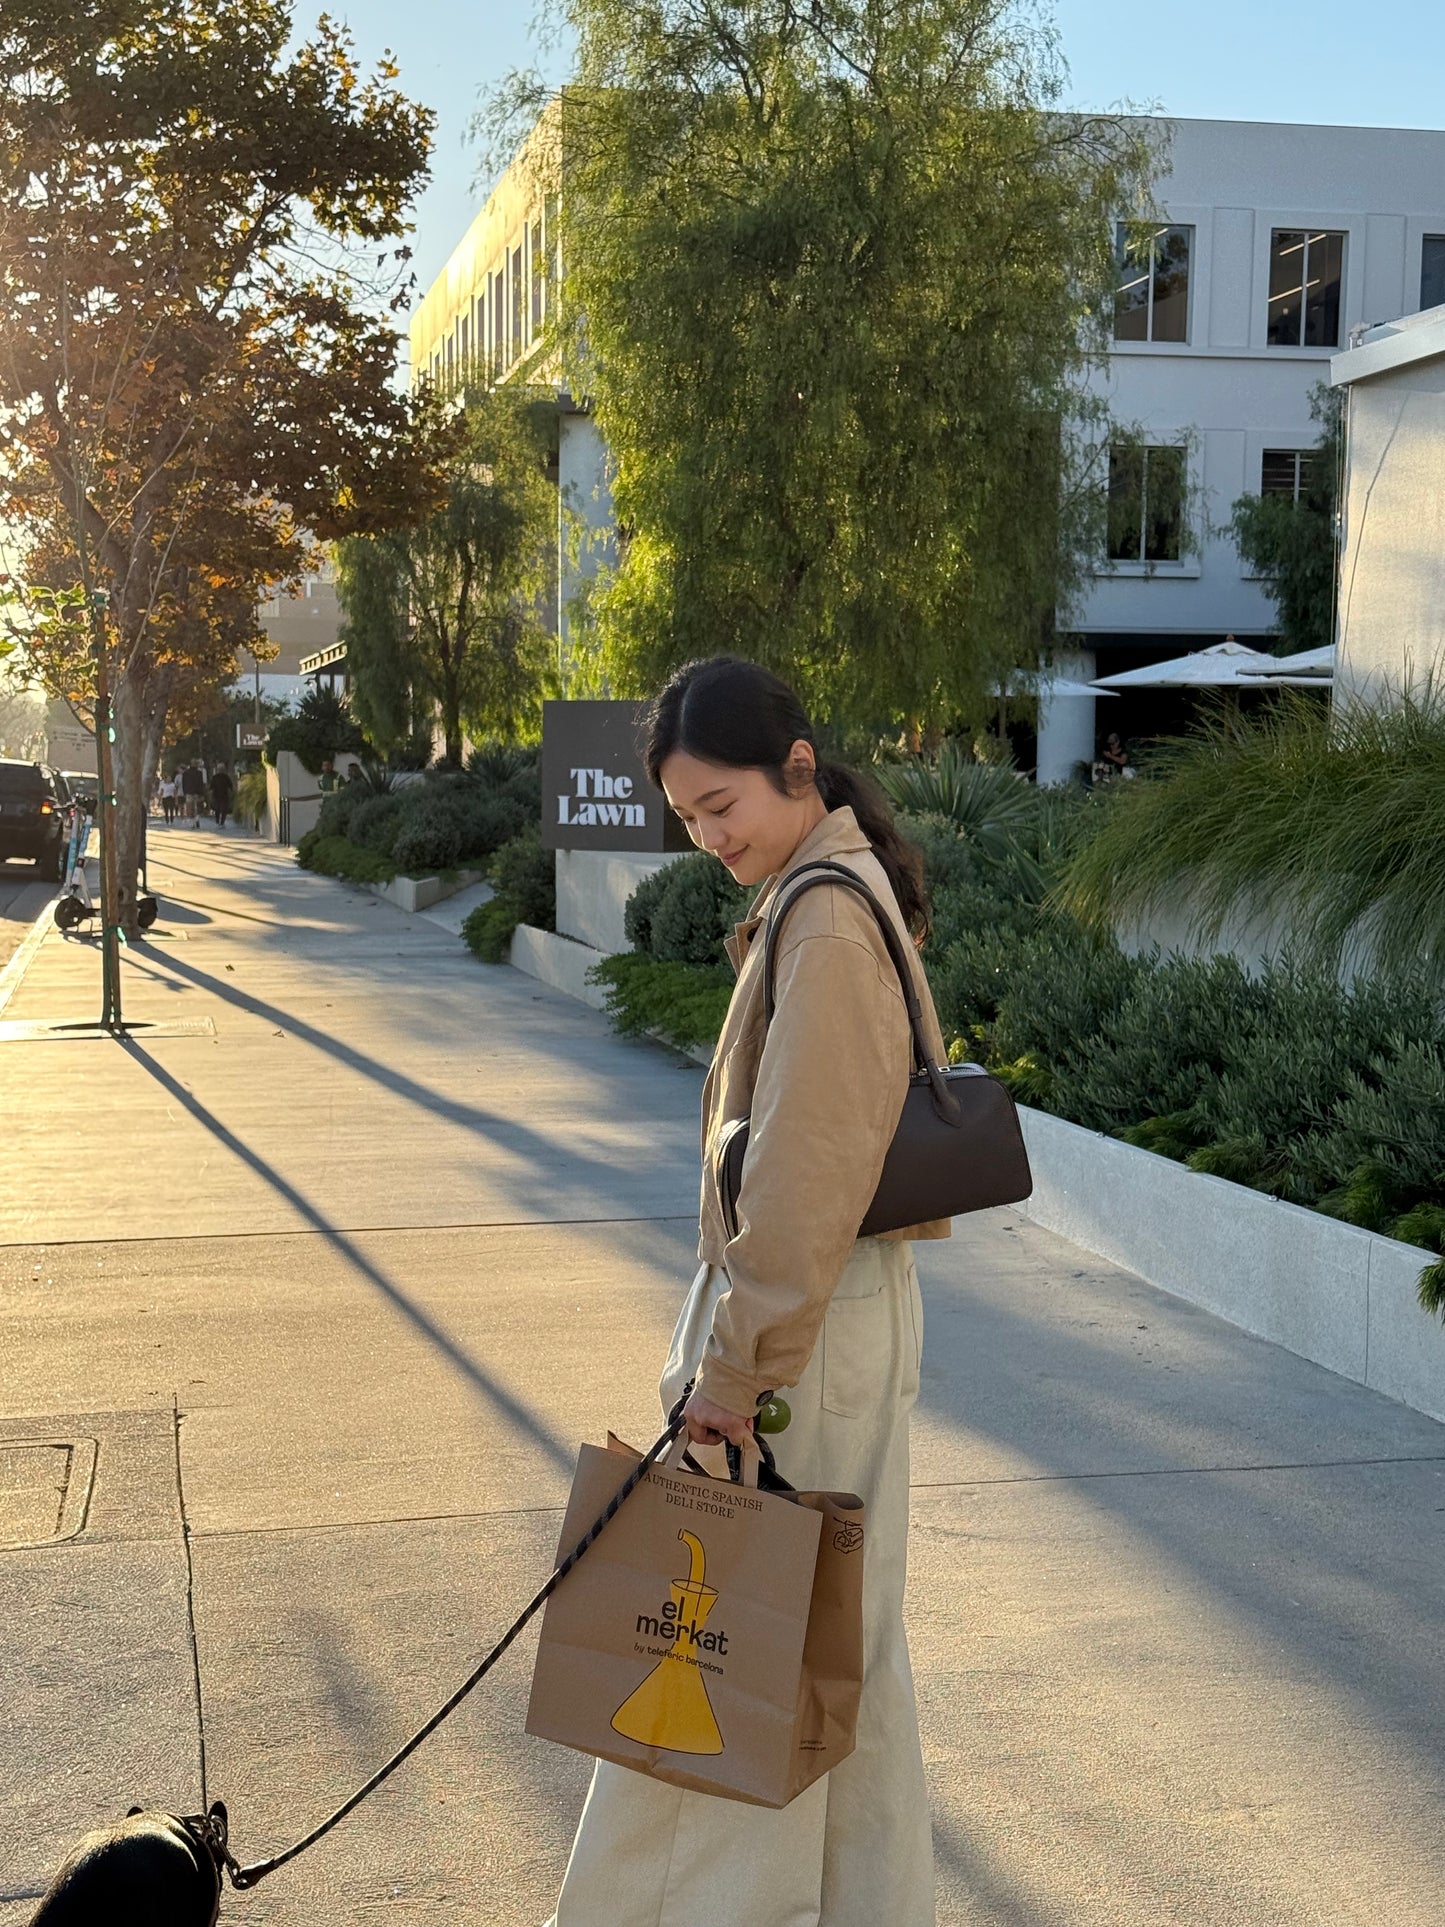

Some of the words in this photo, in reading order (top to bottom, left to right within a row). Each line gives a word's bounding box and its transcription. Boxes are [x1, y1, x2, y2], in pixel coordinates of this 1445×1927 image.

[570, 768, 633, 799] The
[557, 796, 646, 827] Lawn
[644, 1472, 710, 1499] AUTHENTIC
[711, 1490, 764, 1512] SPANISH
[666, 1493, 693, 1509] DELI
[696, 1501, 735, 1519] STORE
[661, 1596, 685, 1622] el
[636, 1614, 729, 1655] merkat
[633, 1642, 645, 1654] by
[685, 1654, 724, 1675] barcelona
